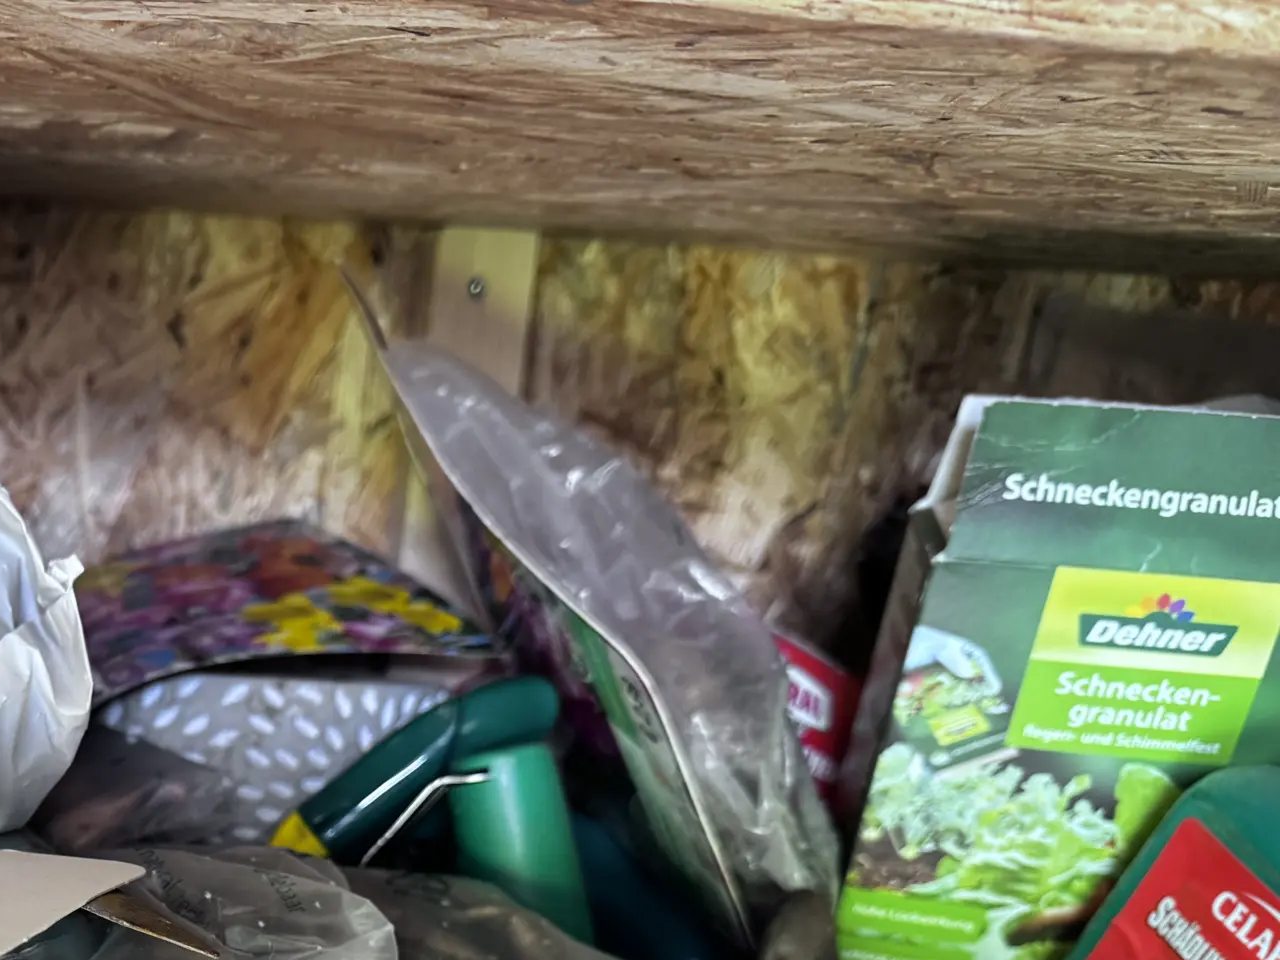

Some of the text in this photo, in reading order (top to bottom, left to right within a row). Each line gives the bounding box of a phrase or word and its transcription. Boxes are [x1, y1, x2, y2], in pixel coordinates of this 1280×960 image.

[1002, 472, 1280, 519] Schneckengranulat
[1084, 618, 1228, 653] Dehner
[1054, 671, 1221, 707] Schnecken-
[1067, 703, 1193, 733] granulat
